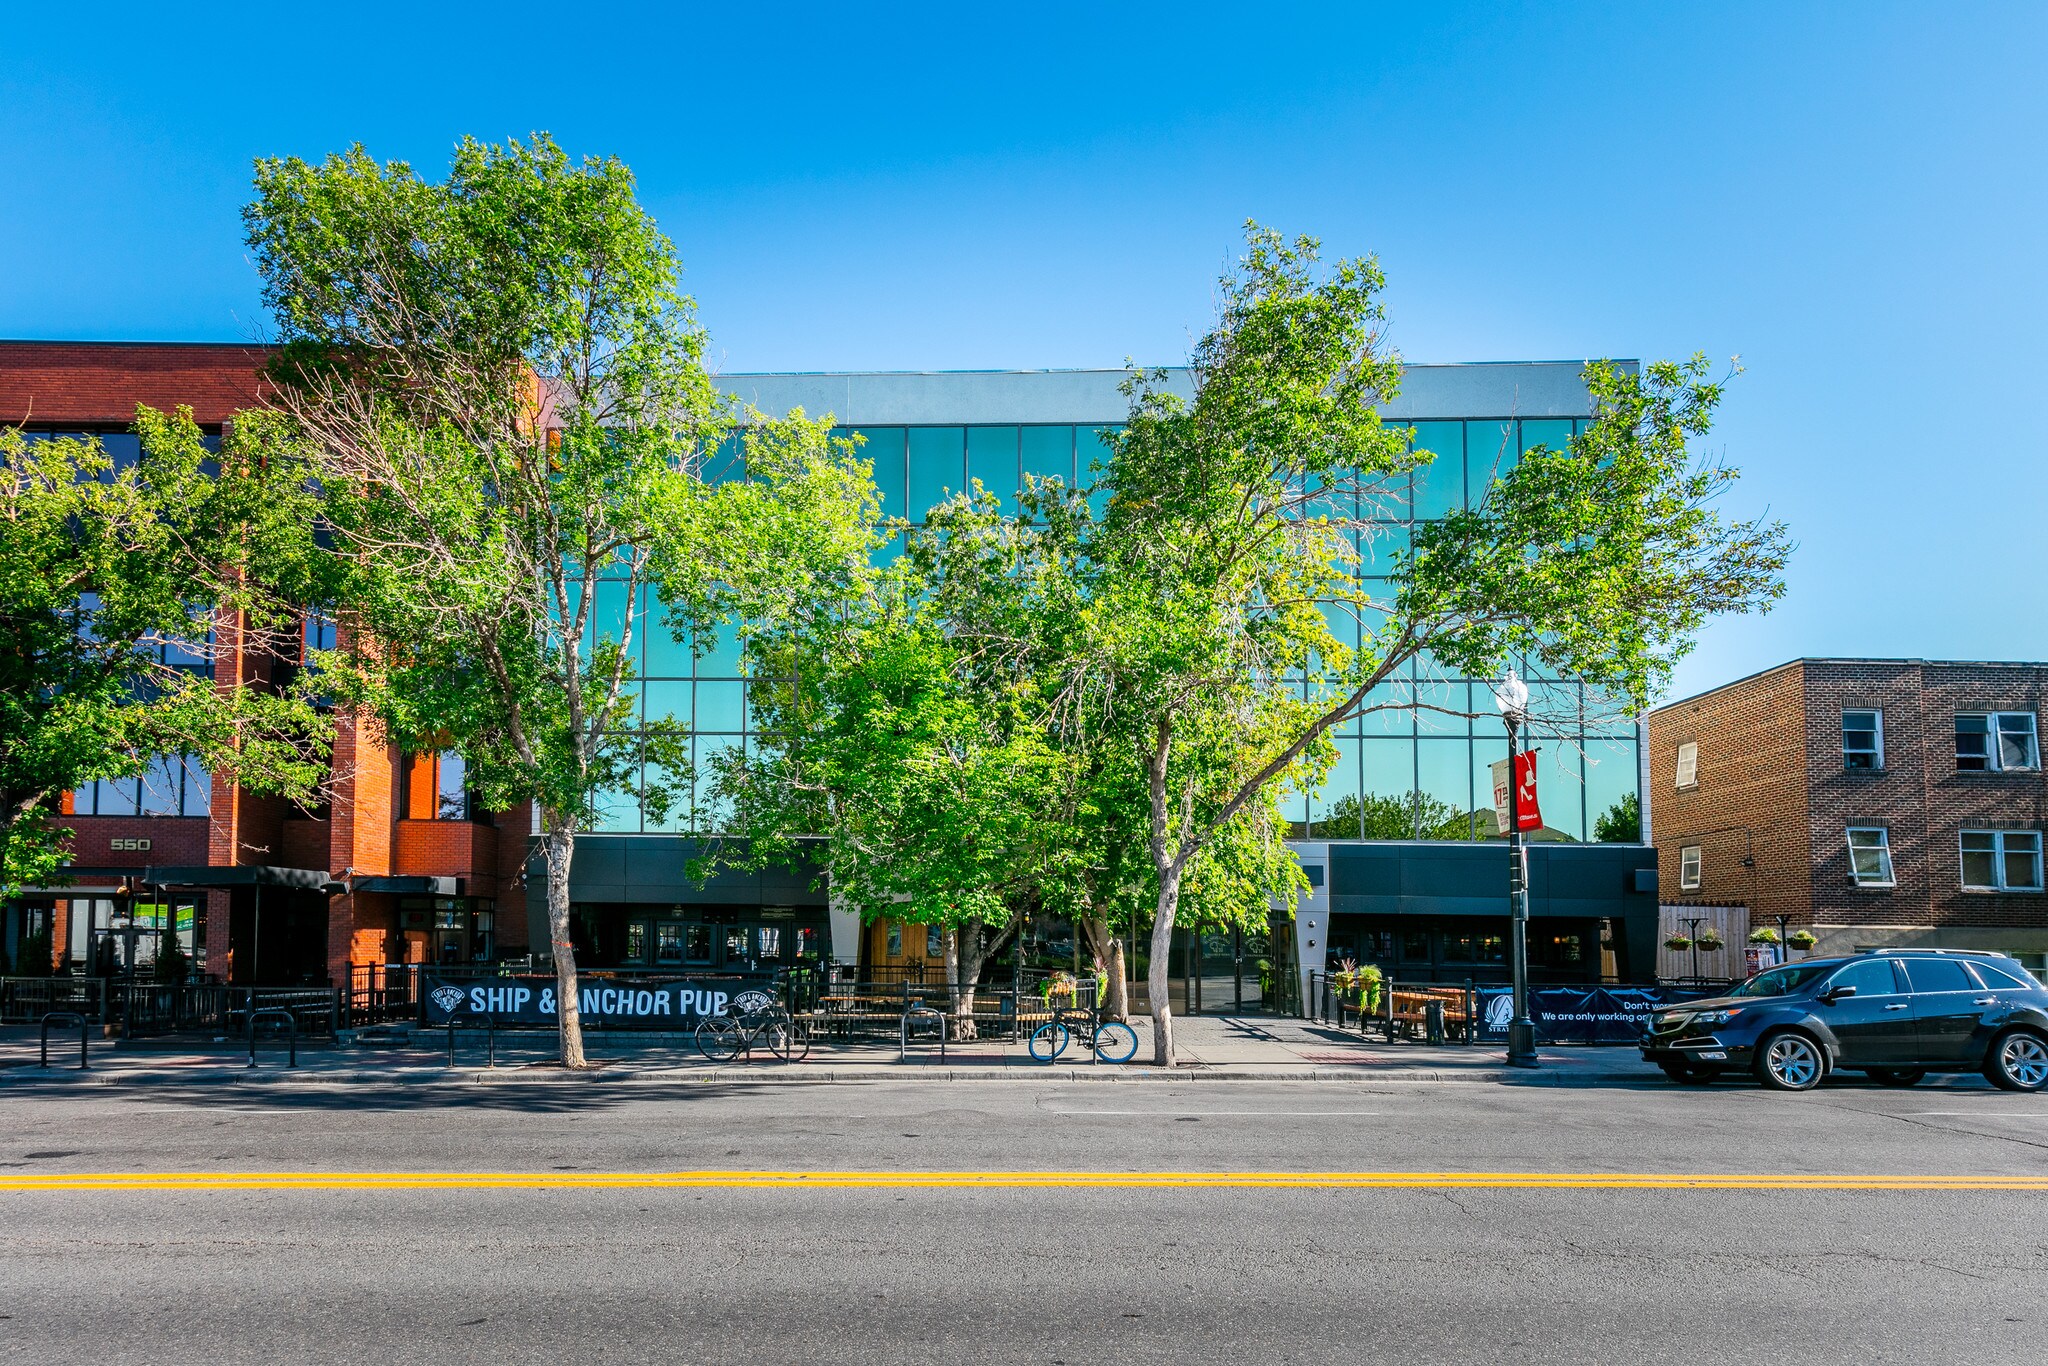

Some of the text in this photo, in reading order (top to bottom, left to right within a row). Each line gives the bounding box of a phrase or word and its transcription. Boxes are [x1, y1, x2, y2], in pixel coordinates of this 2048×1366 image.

[111, 838, 151, 851] 550
[470, 987, 531, 1014] SHIP
[539, 988, 556, 1014] &
[680, 989, 729, 1017] PUB
[1623, 1001, 1650, 1010] Don't
[1541, 1012, 1557, 1021] We
[1558, 1013, 1574, 1021] are
[1575, 1012, 1596, 1022] only
[1596, 1012, 1635, 1023] working
